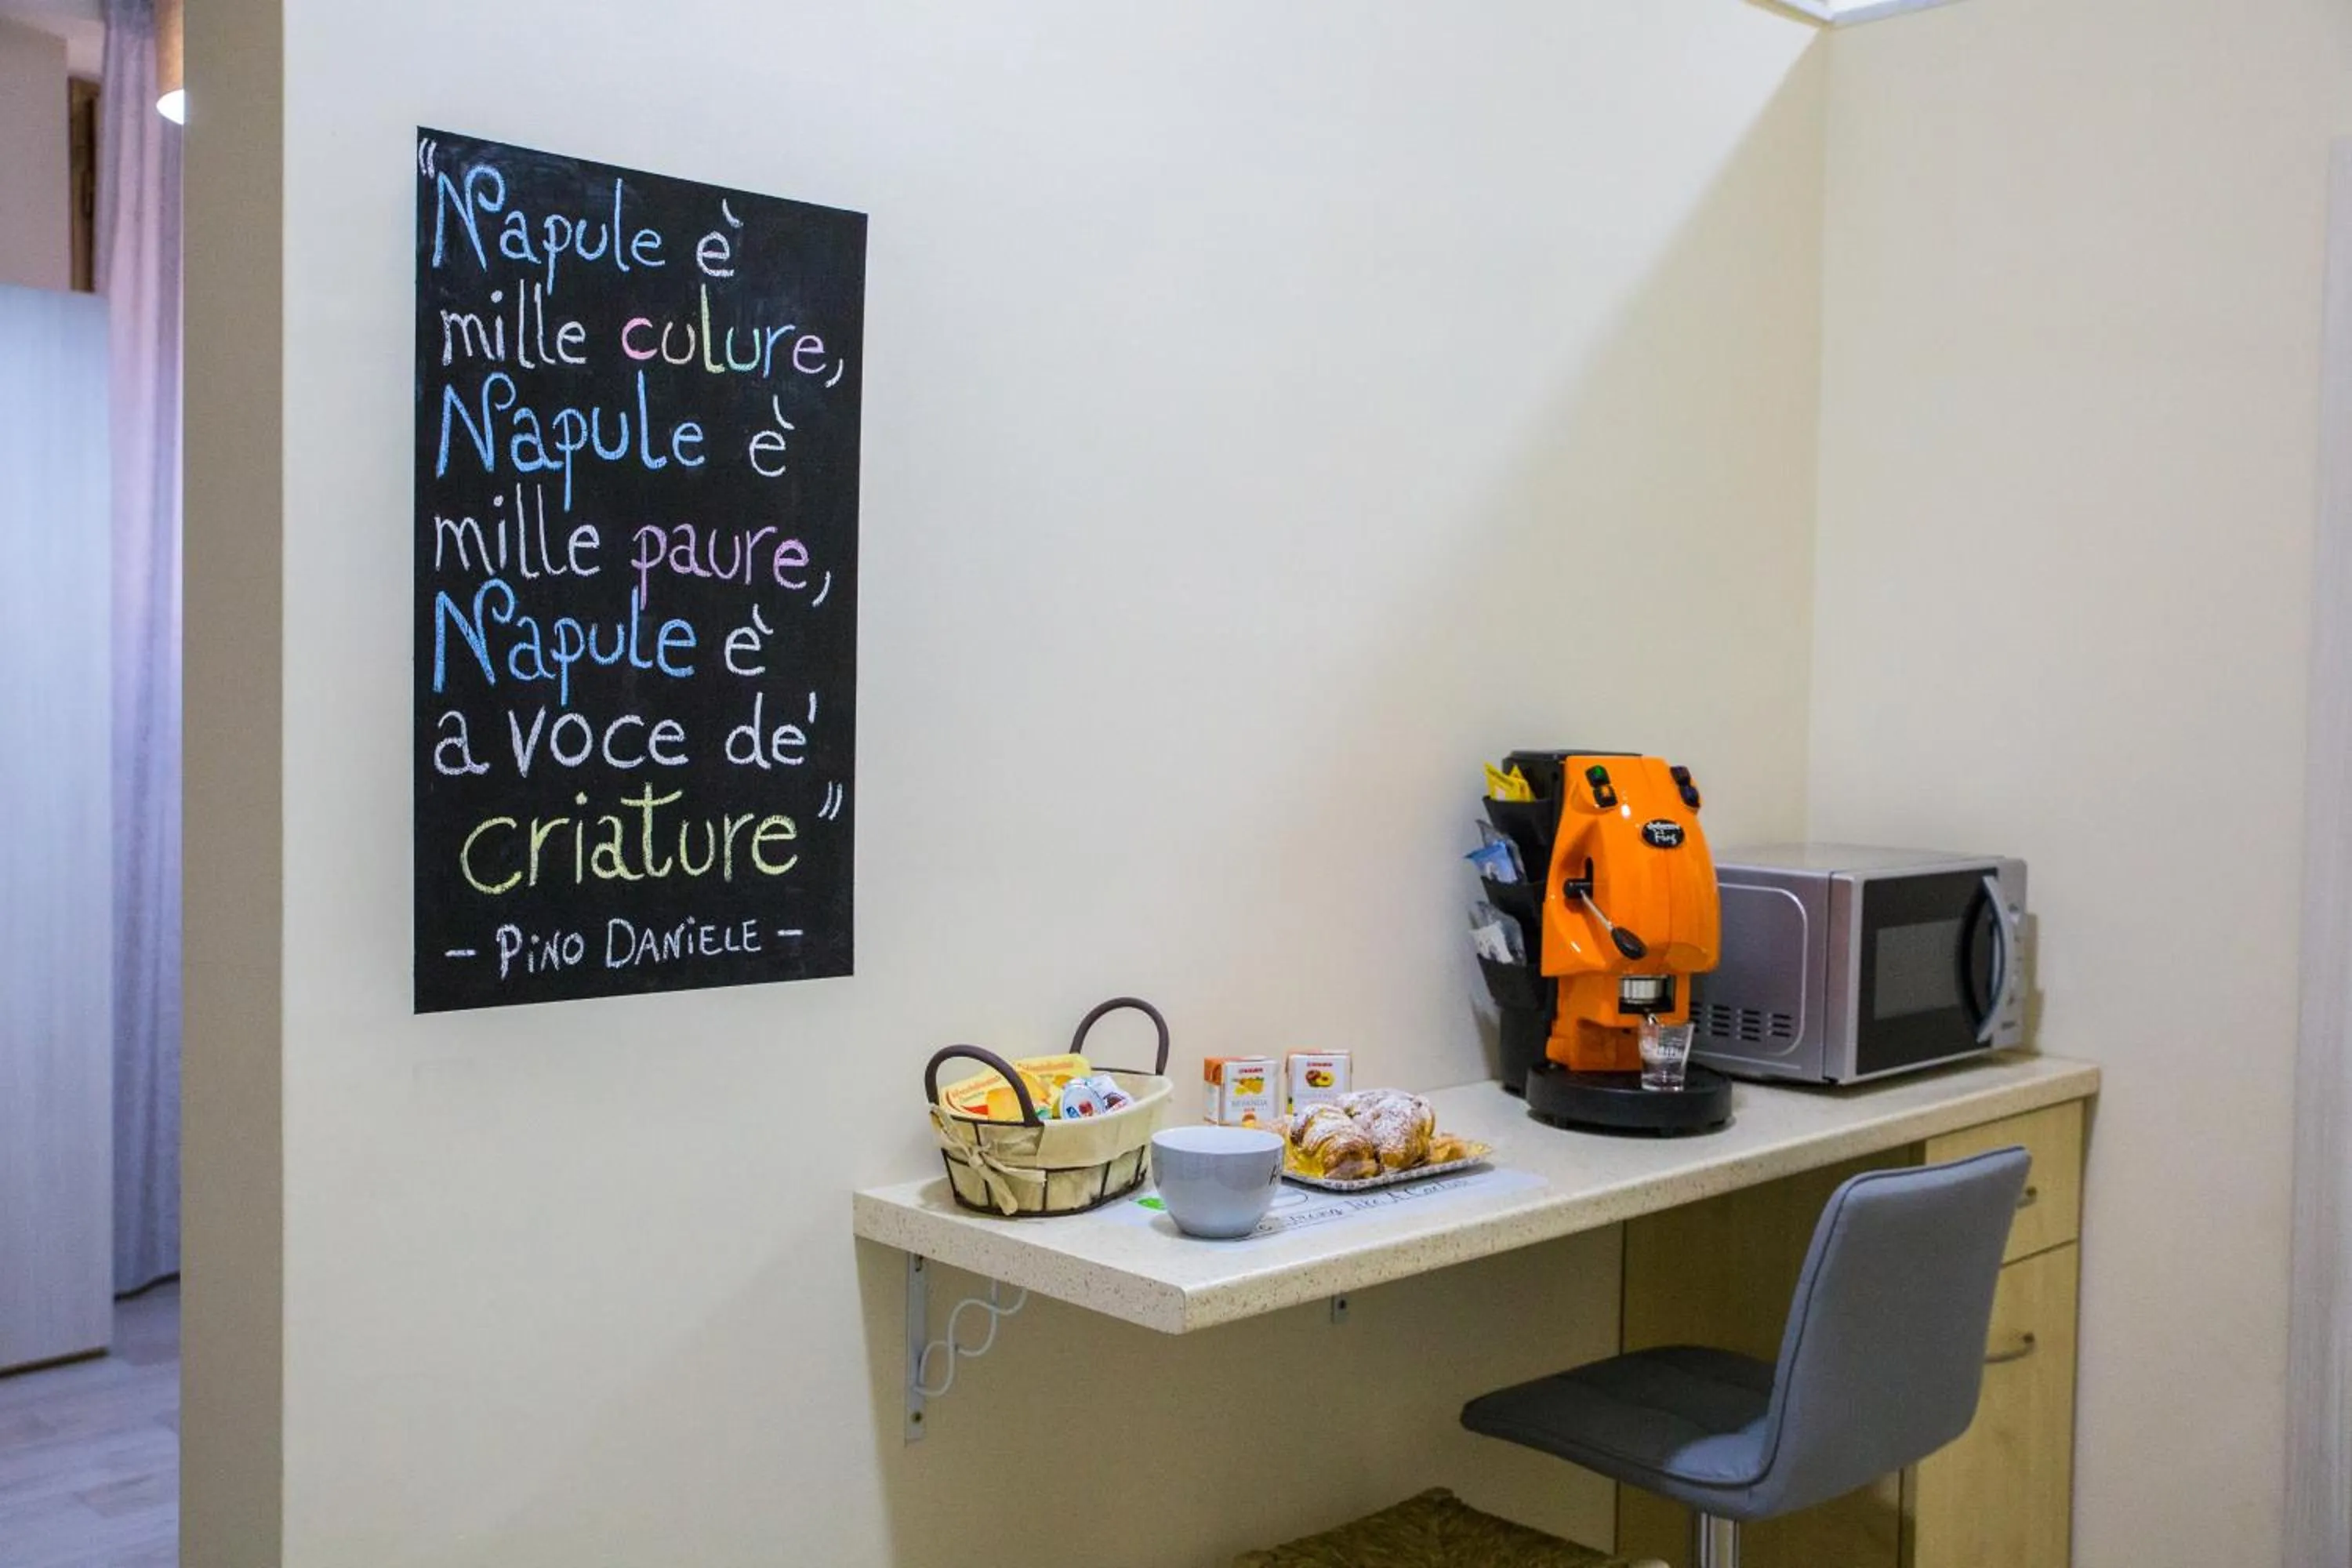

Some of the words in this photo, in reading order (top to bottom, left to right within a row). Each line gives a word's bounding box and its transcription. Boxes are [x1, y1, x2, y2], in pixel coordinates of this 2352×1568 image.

[696, 198, 744, 277] è
[440, 279, 587, 369] mille
[622, 284, 844, 388] culure,
[437, 372, 706, 512] Napule
[750, 395, 795, 477] è
[434, 483, 601, 578] mille
[631, 523, 830, 610] paure,
[433, 579, 696, 706] Napule
[434, 710, 490, 775] a
